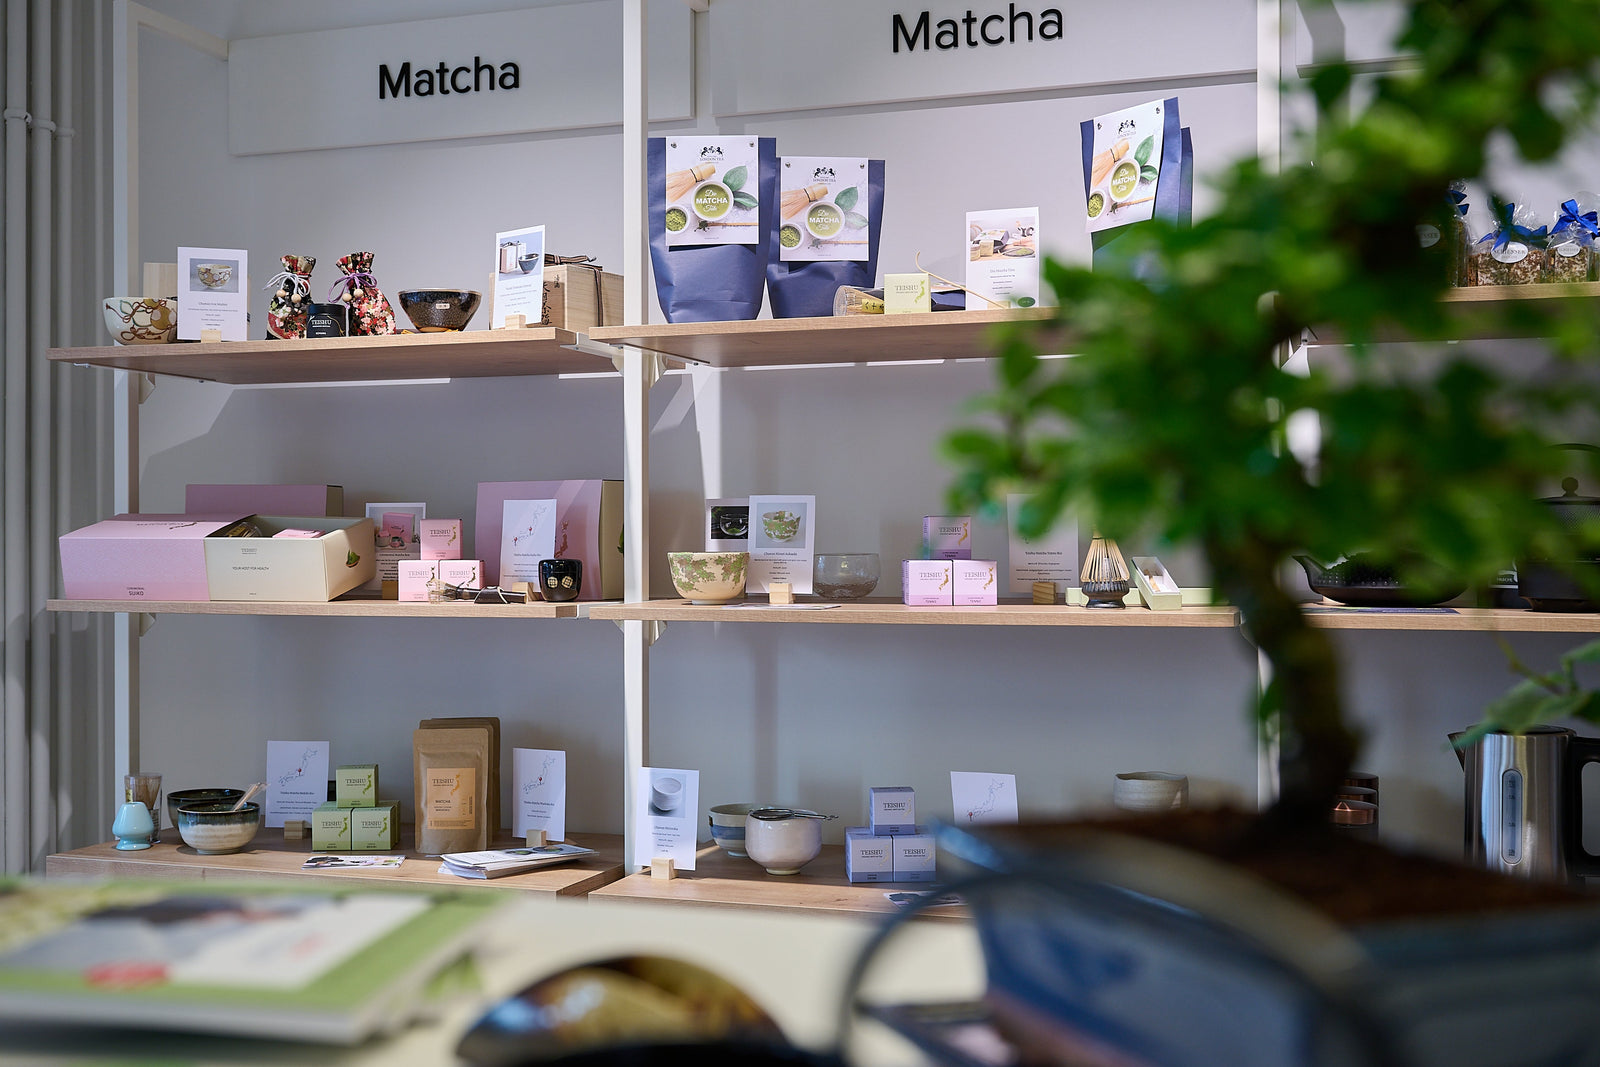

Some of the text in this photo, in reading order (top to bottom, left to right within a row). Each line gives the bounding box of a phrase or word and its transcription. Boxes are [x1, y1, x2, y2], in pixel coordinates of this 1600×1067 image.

[893, 3, 1063, 52] Matcha
[379, 56, 520, 99] Matcha
[1112, 175, 1136, 186] MATCHA
